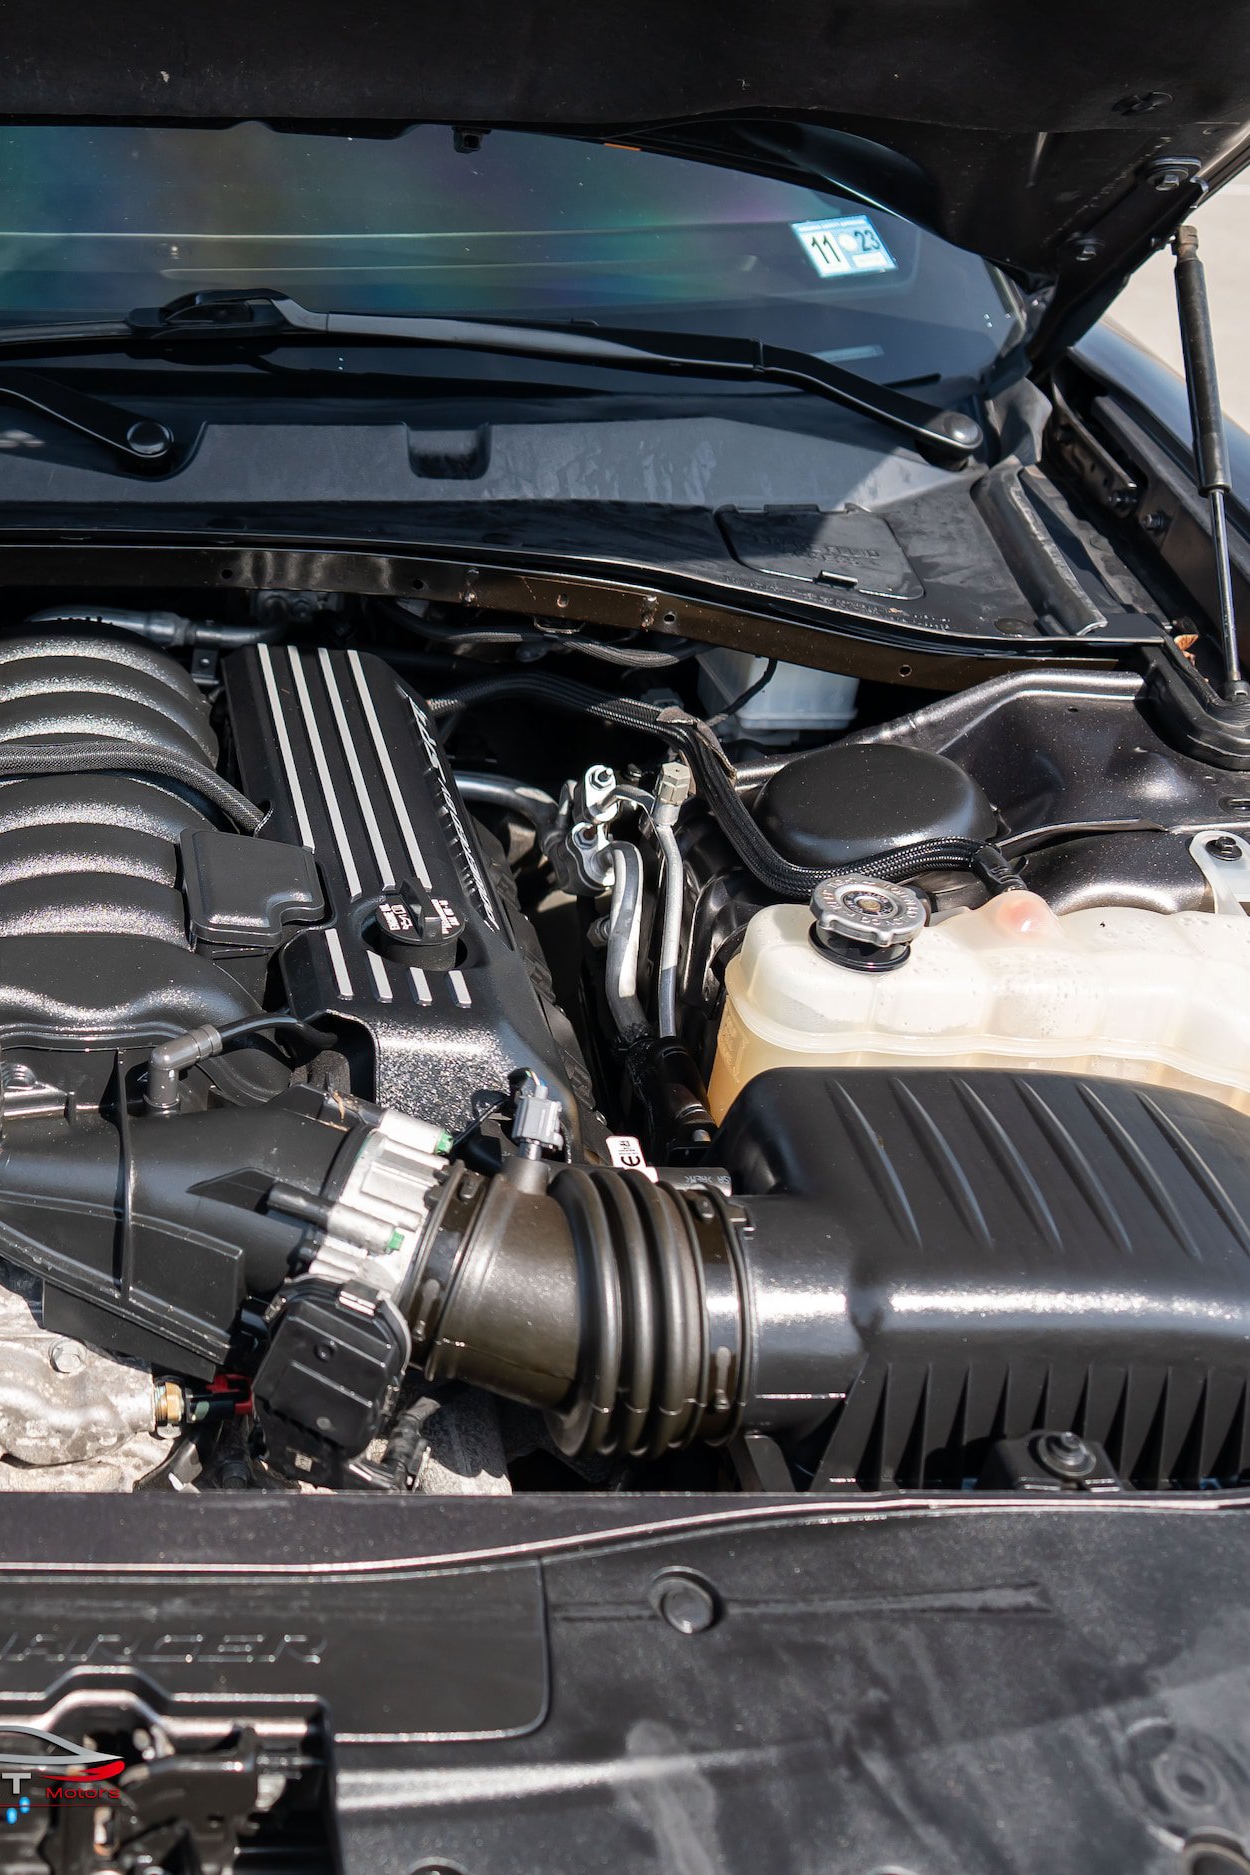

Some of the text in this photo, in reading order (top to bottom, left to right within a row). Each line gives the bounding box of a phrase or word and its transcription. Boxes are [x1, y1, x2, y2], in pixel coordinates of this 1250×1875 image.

[811, 229, 881, 264] 11 23
[451, 811, 500, 931] POWERED
